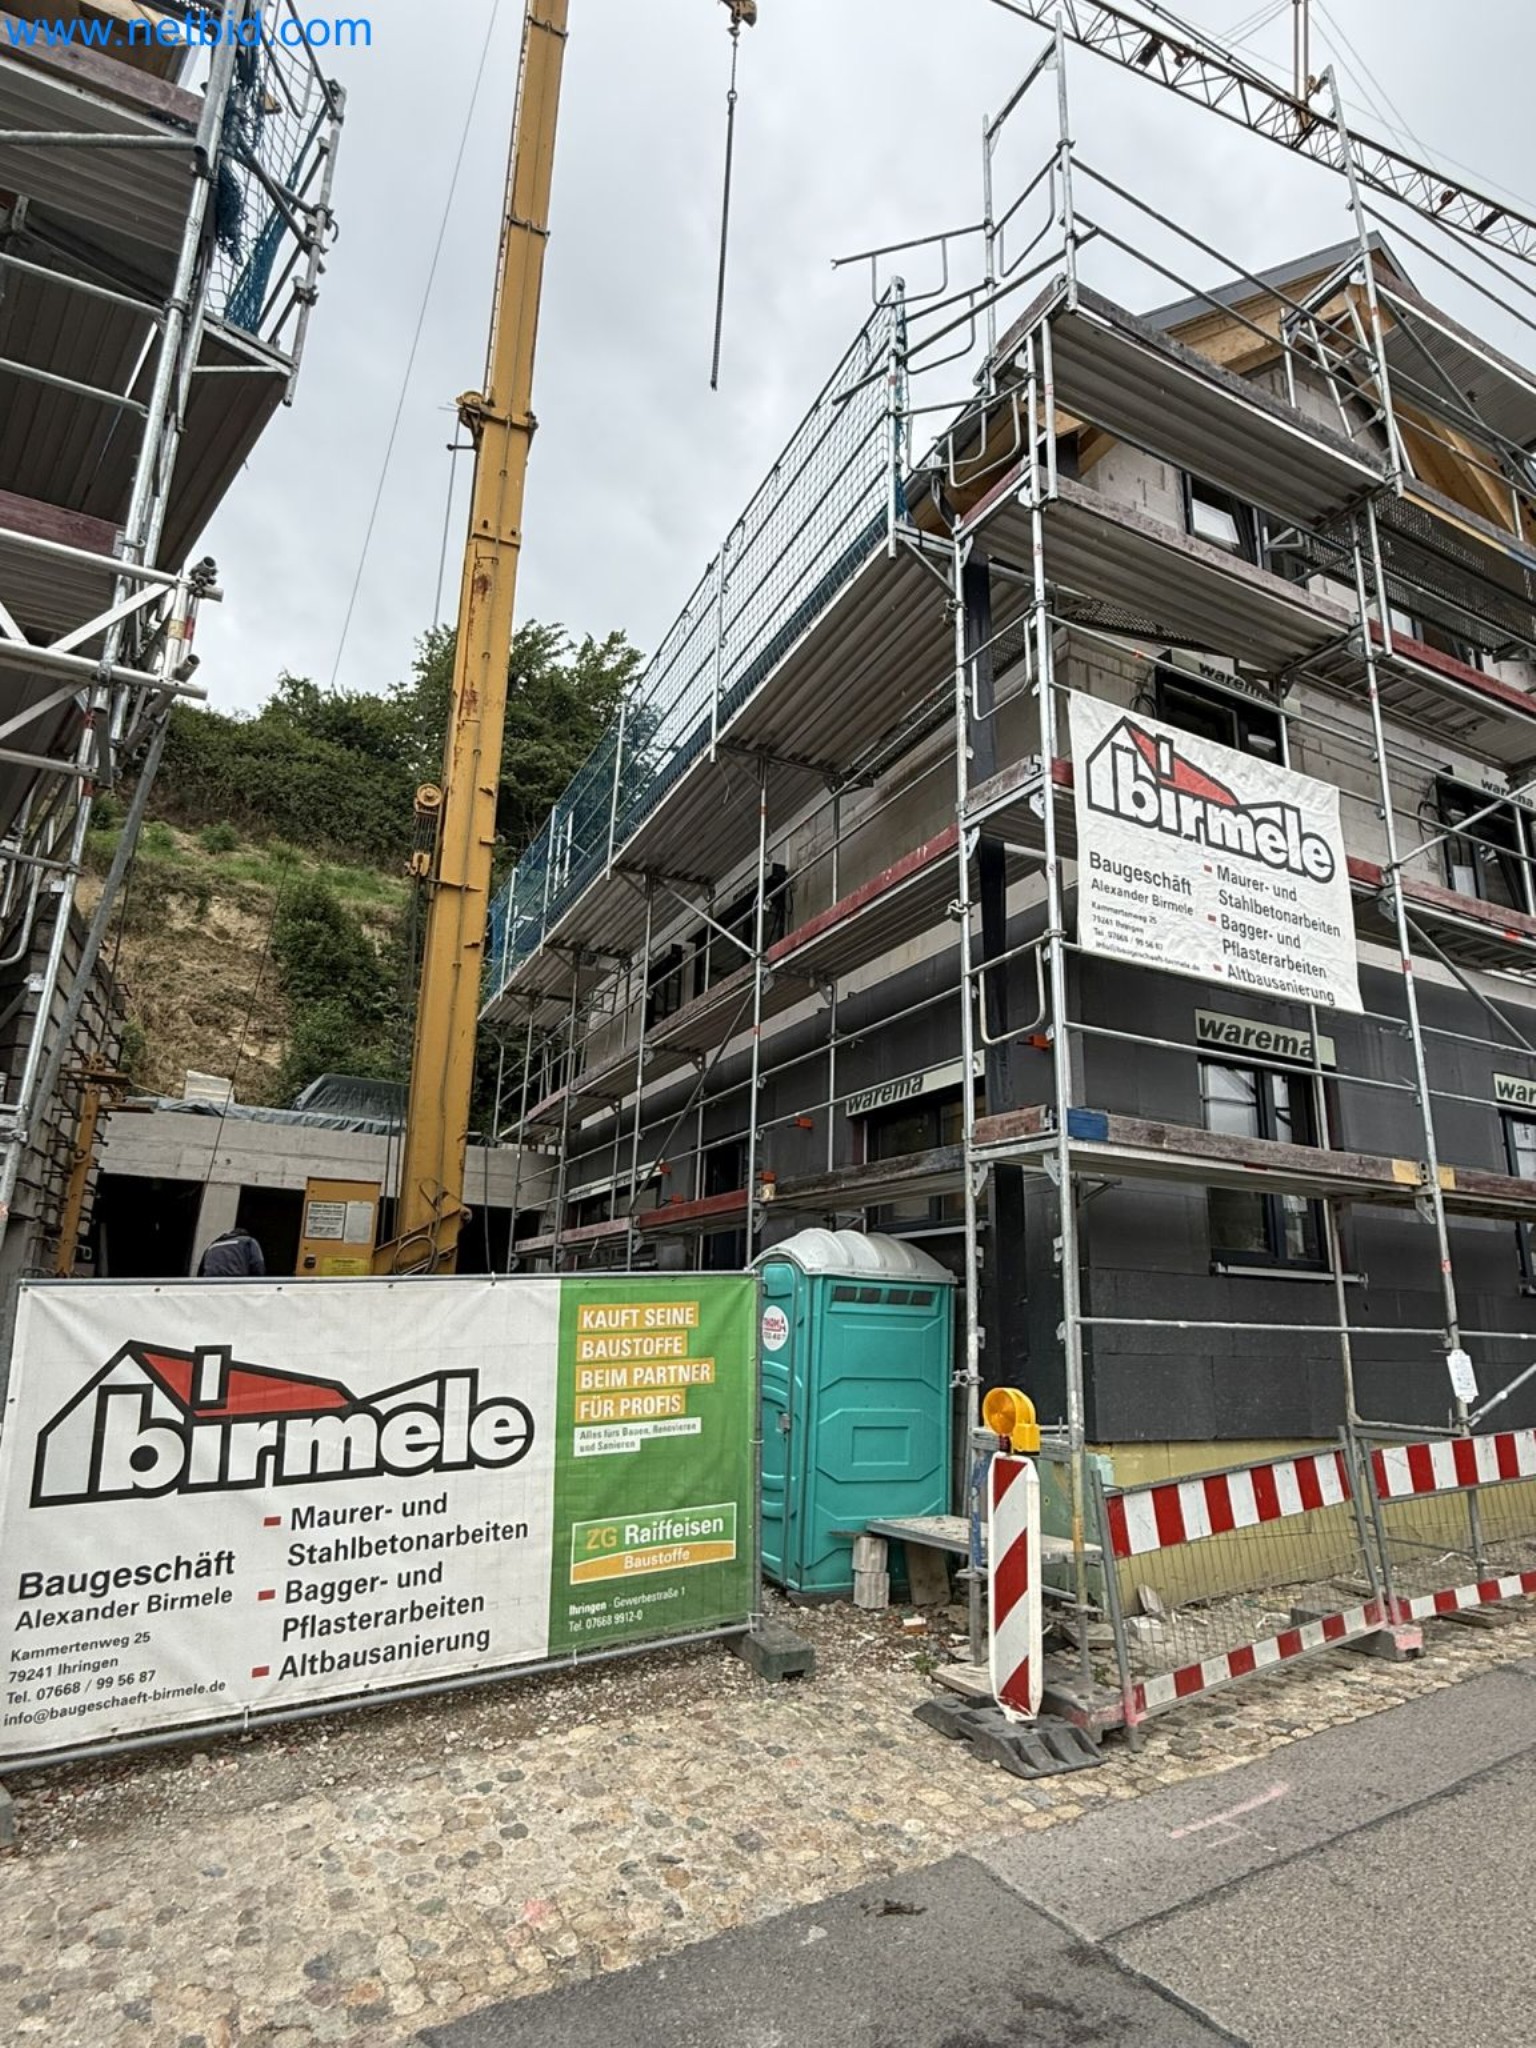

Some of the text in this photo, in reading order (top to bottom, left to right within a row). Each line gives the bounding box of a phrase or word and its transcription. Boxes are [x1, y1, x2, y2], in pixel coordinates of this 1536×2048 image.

[1111, 733, 1336, 884] birmele
[1089, 851, 1192, 896] Baugeschäft
[1217, 864, 1298, 901] Maurer- und
[1091, 878, 1194, 916] Alexander Birmele
[1219, 889, 1341, 938] Stahlbetonarbeiten
[1220, 913, 1302, 949] Bagger- und
[1222, 939, 1327, 978] Pflasterarbeiten
[1227, 964, 1336, 1006] Altbausanierung
[1198, 1017, 1313, 1059] warema
[582, 1307, 695, 1329] KAUFT SEINE
[581, 1336, 683, 1359] BAUSTOFFE
[581, 1363, 711, 1389] BEIM PARTNER
[94, 1344, 535, 1500] birmele
[580, 1394, 681, 1420] FÜR PROFIS
[290, 1492, 448, 1532] Maurer- und
[287, 1521, 529, 1566] Stahlbetonarbeiten
[586, 1517, 724, 1550] ZG Raiffeisen
[18, 1550, 236, 1600] Baugeschäft
[624, 1548, 690, 1569] Baustoffe
[285, 1561, 443, 1605] Bagger- und
[14, 1587, 233, 1632] Alexander Birmele
[282, 1592, 485, 1643] Pflasterarbeiten
[11, 1631, 151, 1662] Kammertenweg 25
[278, 1628, 491, 1682] Altbausanierung
[6, 1690, 31, 1705] Tel.
[36, 1681, 81, 1701] 07668
[96, 1676, 114, 1690] 99
[117, 1672, 135, 1687] 56
[139, 1669, 156, 1683] 87
[8, 1656, 119, 1684] 79241 Ihringen
[3, 1679, 226, 1727] info@baugeschaeft-birmele.de
